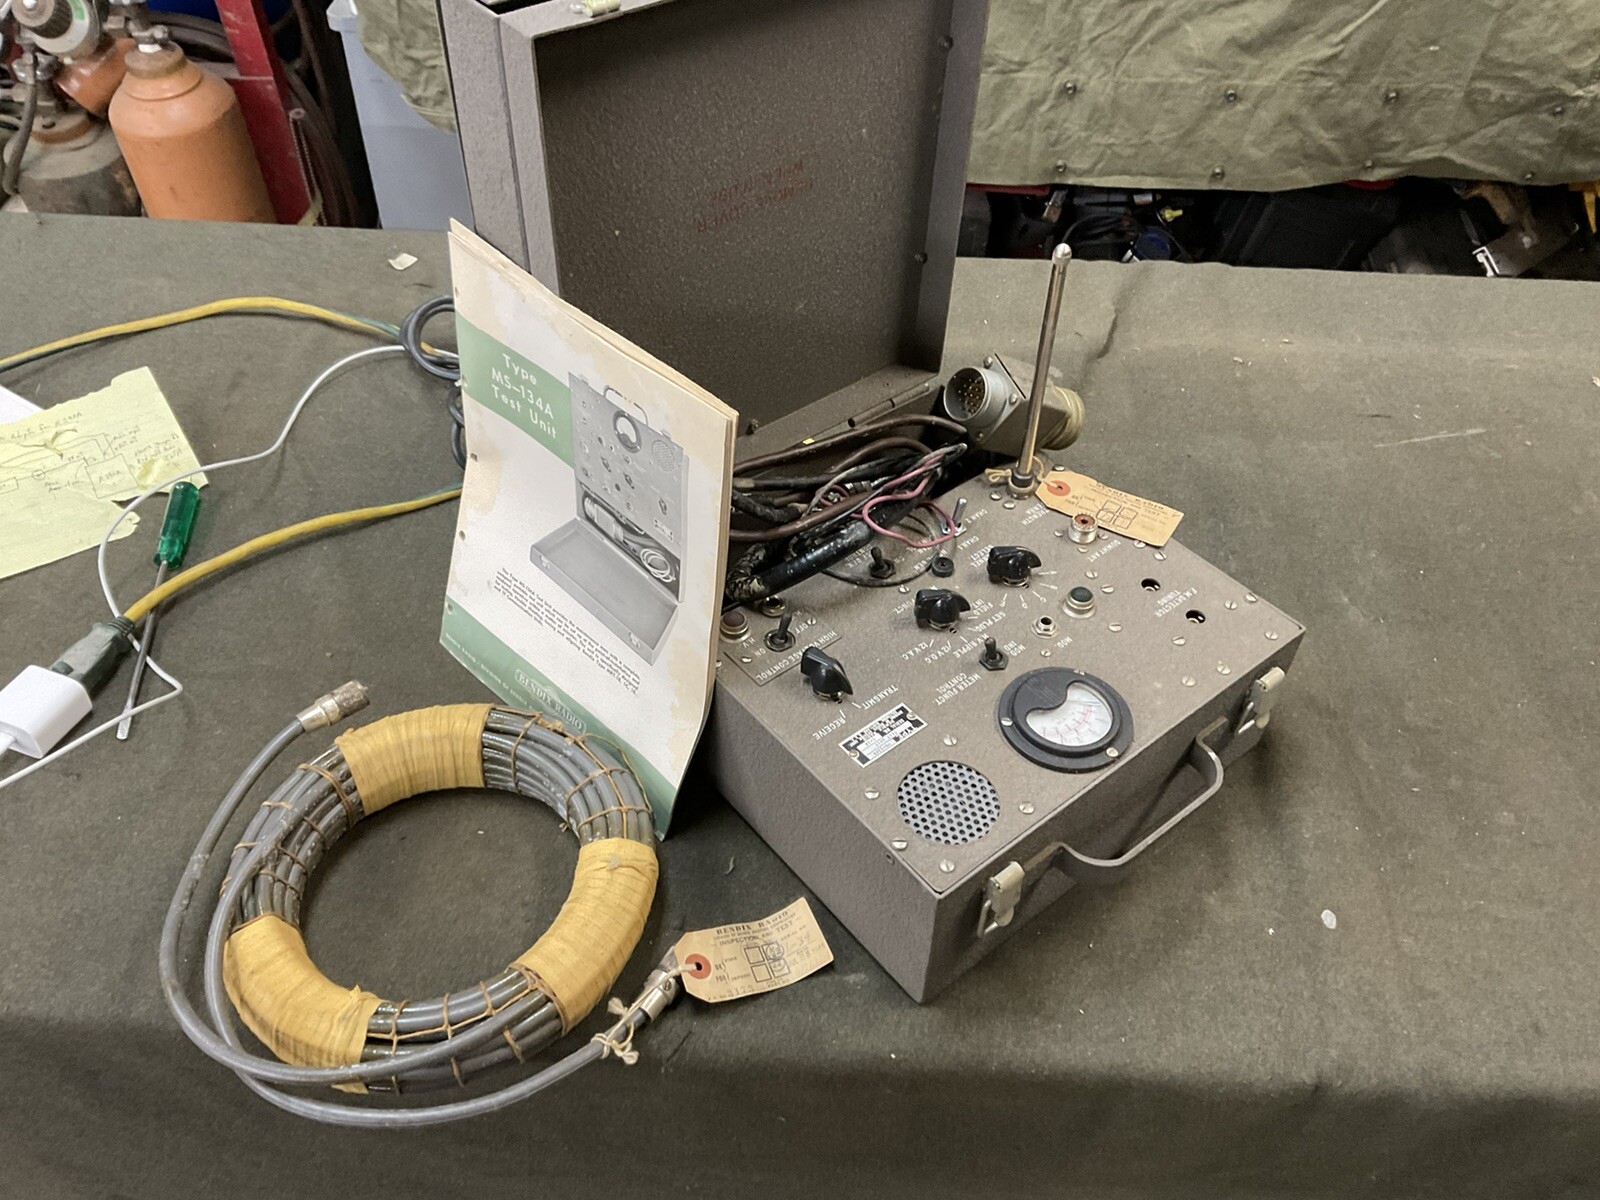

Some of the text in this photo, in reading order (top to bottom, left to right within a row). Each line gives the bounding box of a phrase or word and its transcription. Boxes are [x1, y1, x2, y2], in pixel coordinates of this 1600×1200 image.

[502, 353, 536, 385] Type
[492, 367, 554, 419] MS-134A
[492, 384, 557, 439] Test Unit
[754, 658, 789, 681] CONTROL
[934, 671, 967, 694] CONTROL
[518, 673, 582, 730] BENDIX RADIO
[863, 684, 898, 710] TRANSMIT
[812, 718, 846, 741] RECEIVE
[716, 924, 752, 936] BENDIX
[776, 921, 794, 933] TEST
